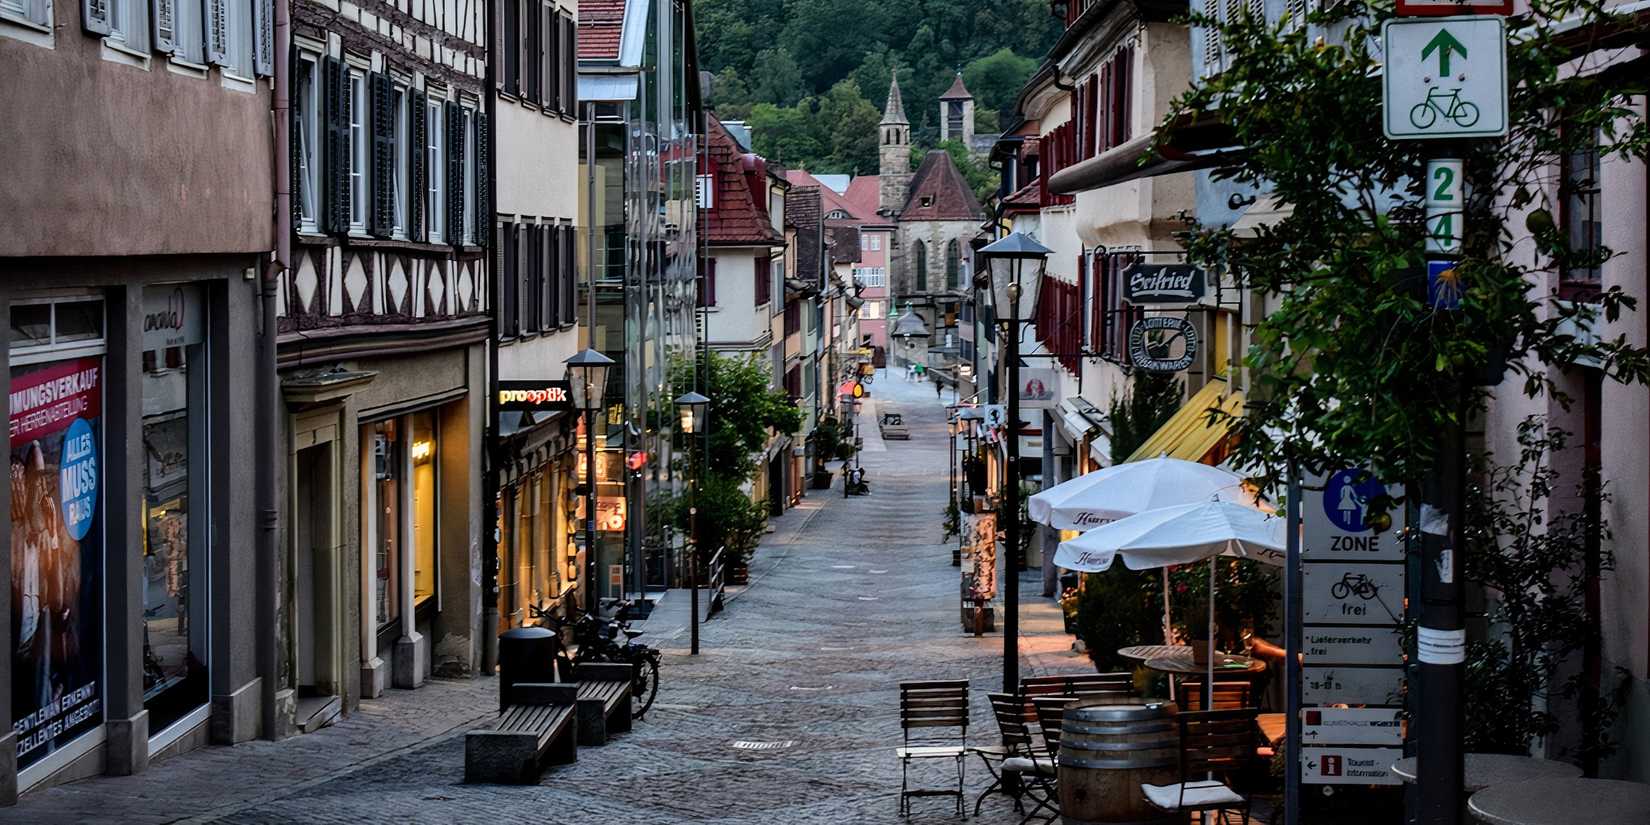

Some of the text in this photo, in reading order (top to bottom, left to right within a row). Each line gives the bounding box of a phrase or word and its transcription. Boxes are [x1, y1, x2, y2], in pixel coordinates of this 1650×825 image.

[1433, 167, 1454, 201] 2
[1435, 215, 1454, 247] 4
[1130, 267, 1196, 296] Seifried
[66, 432, 91, 463] ALLES
[62, 456, 96, 503] MUSS
[69, 496, 91, 526] RAUS
[1330, 535, 1380, 552] ZONE
[1342, 602, 1367, 616] frei
[1311, 635, 1372, 645] Lieferverkehr
[1311, 647, 1328, 655] frei
